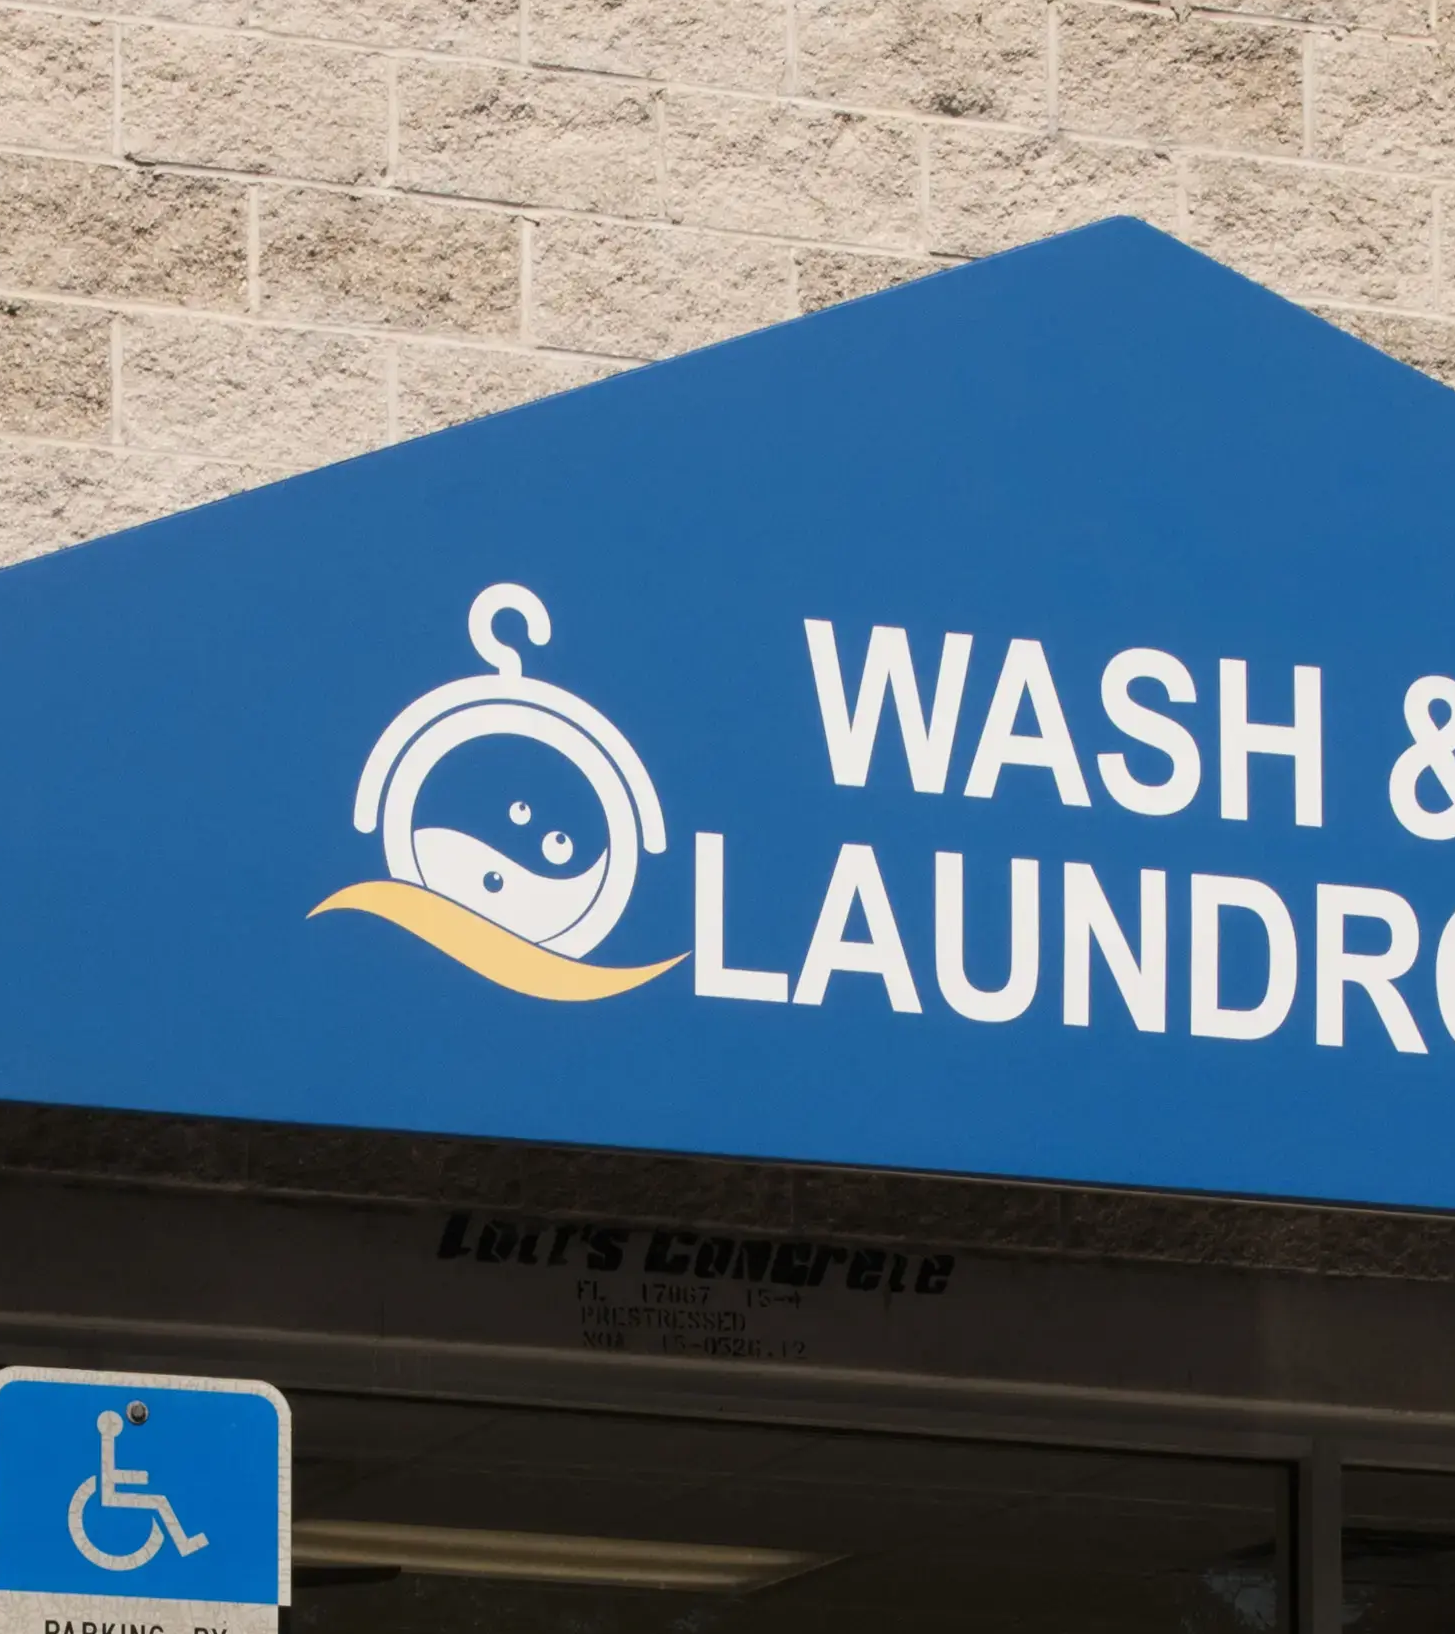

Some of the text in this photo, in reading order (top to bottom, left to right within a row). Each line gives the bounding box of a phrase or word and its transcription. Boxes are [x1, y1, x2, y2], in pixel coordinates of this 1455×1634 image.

[803, 618, 1323, 828] WASH
[644, 1225, 956, 1294] Concrete
[580, 1306, 746, 1334] PRESTRESSED
